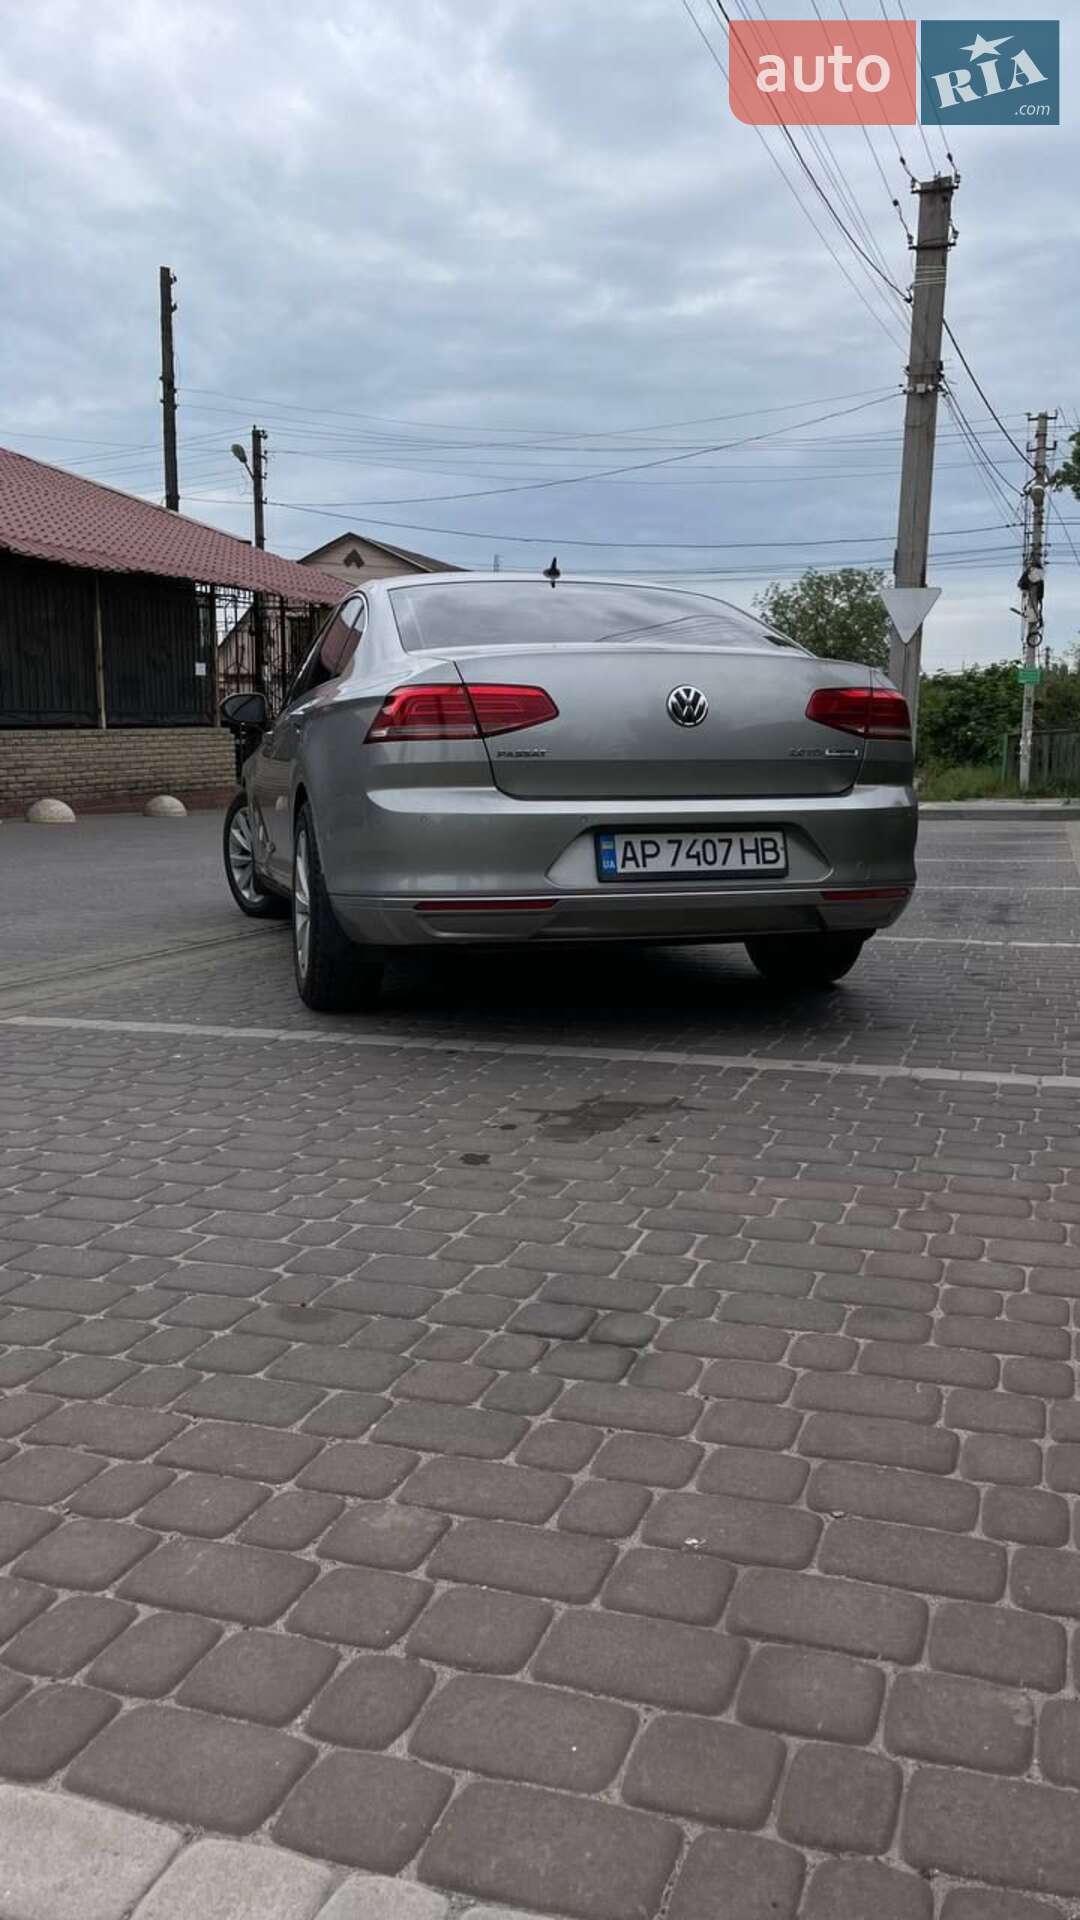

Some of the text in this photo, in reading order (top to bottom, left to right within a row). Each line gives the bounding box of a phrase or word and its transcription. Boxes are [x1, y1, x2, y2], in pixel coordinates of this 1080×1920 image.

[621, 837, 780, 868] AP 7407 HB
